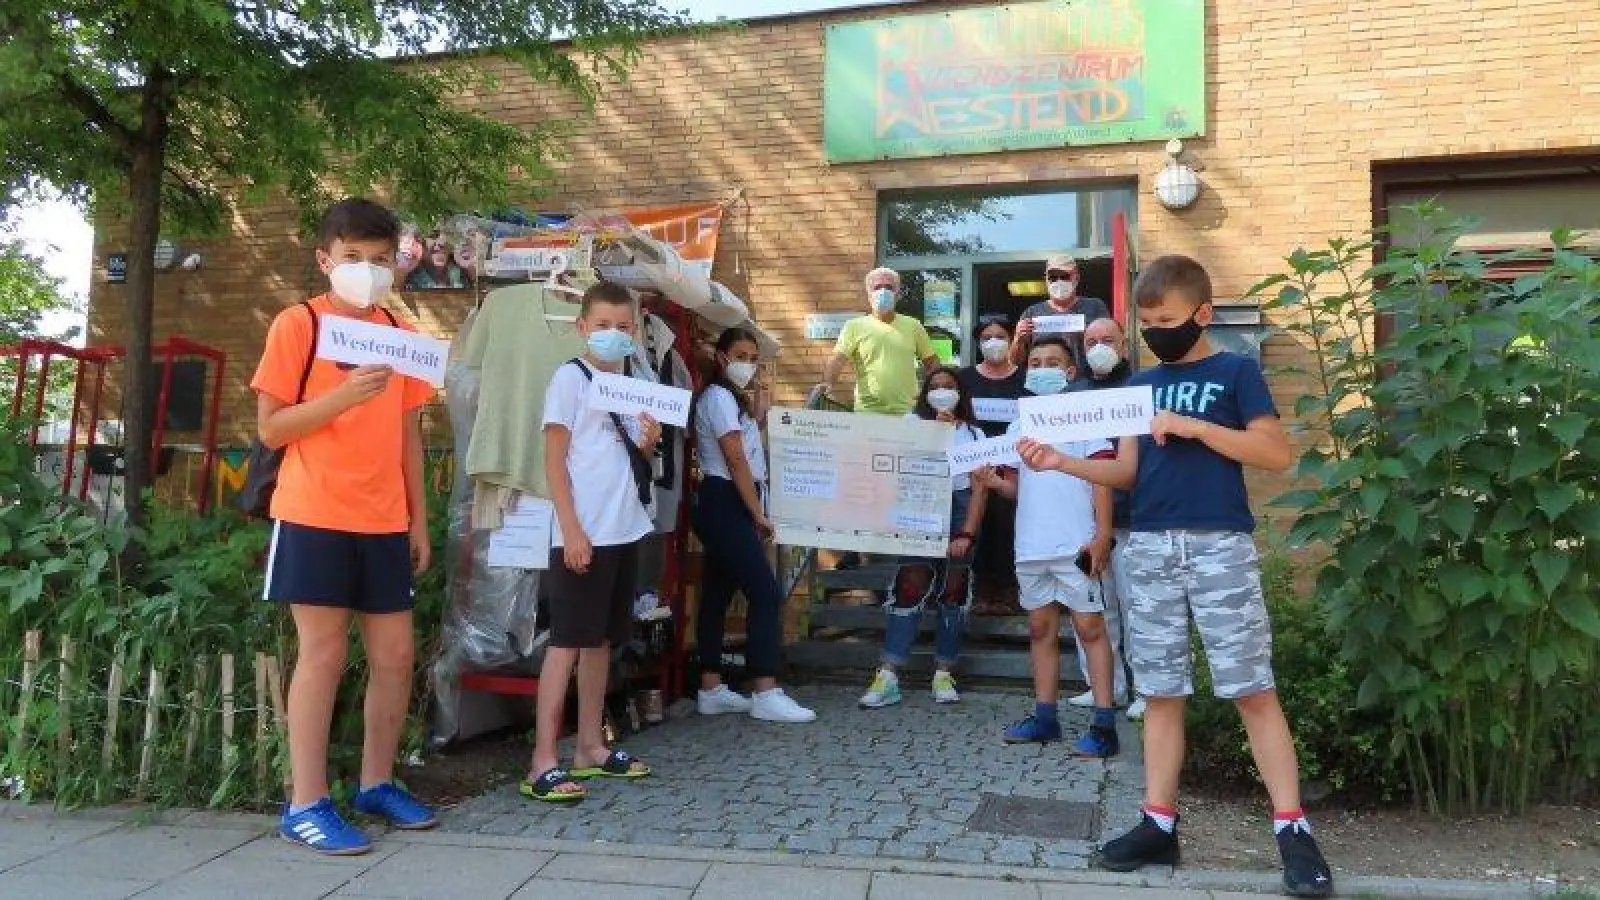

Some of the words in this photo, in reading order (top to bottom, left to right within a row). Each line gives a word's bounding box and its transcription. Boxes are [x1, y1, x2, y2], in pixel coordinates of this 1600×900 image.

[330, 328, 408, 359] Westend
[410, 347, 440, 369] teilt
[598, 384, 656, 408] Westend
[1153, 381, 1225, 413] URF
[1029, 404, 1105, 427] Westend
